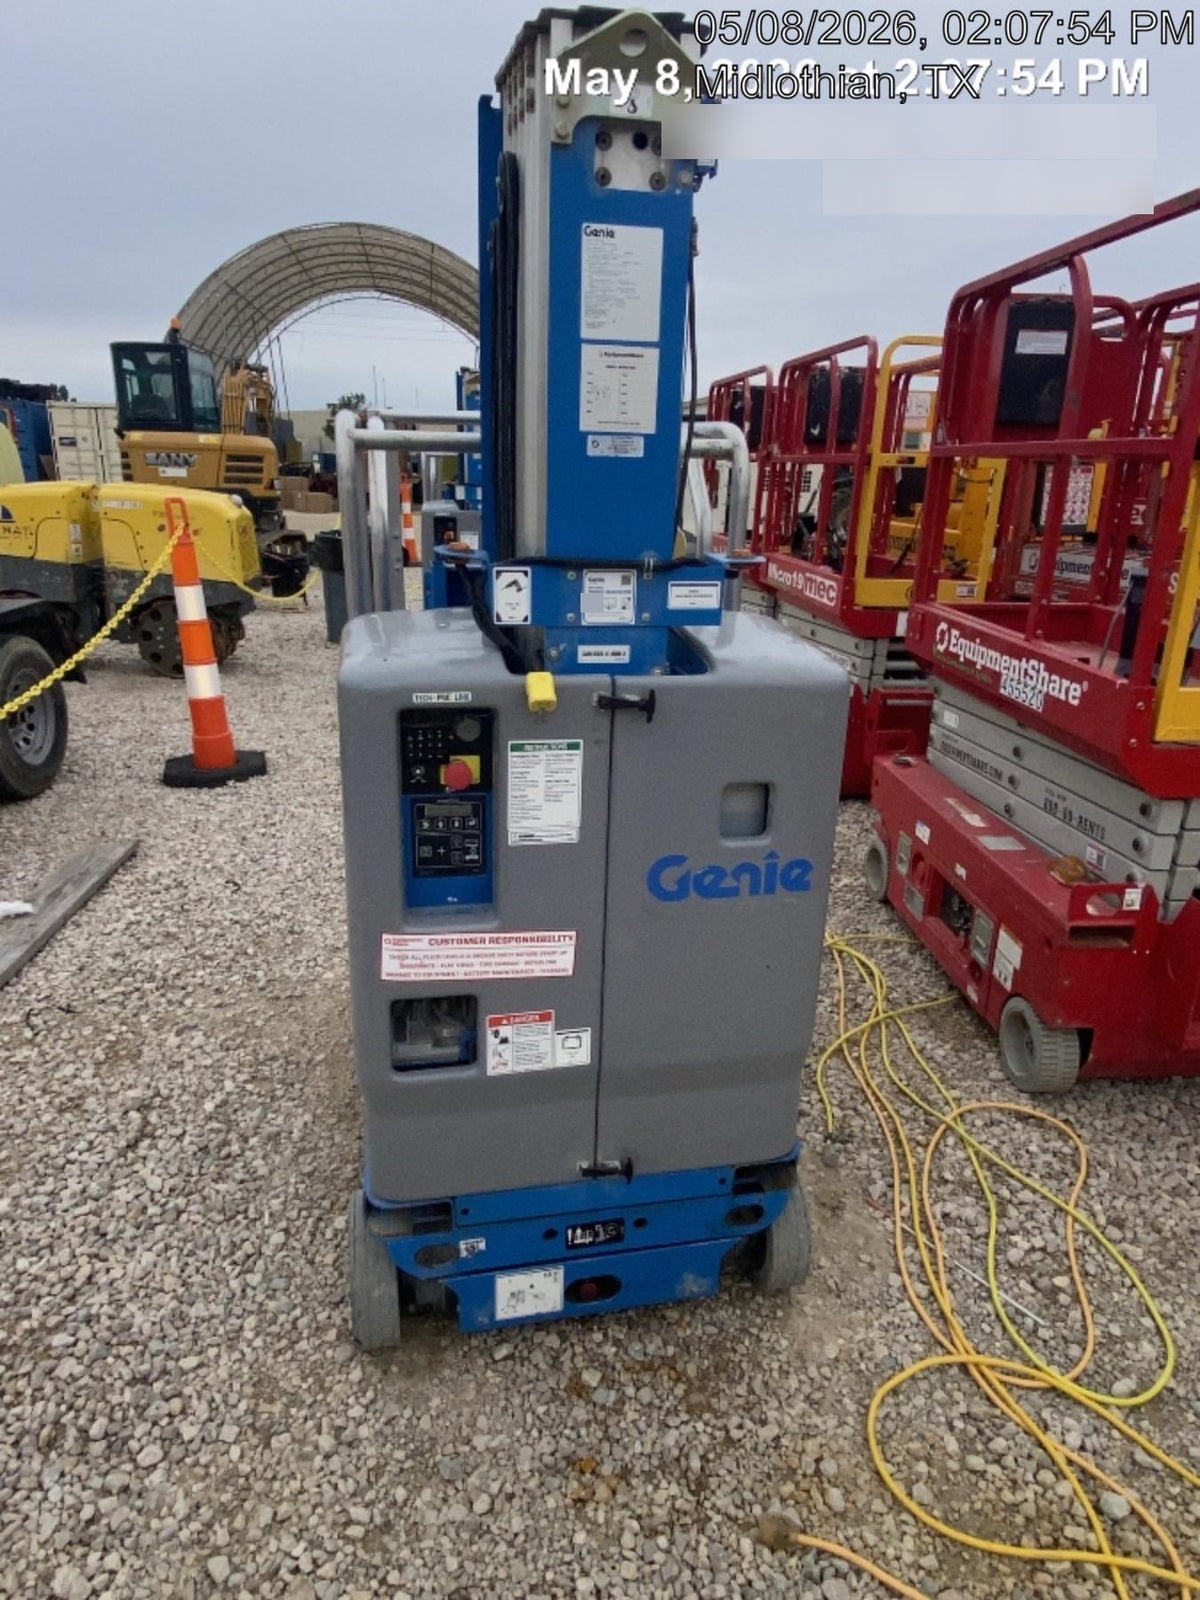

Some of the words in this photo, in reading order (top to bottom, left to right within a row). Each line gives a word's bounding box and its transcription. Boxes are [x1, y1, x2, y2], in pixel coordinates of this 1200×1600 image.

[584, 225, 615, 239] Genie
[145, 452, 198, 468] SANY
[646, 850, 813, 902] Genie
[428, 936, 486, 947] CUSTOMER
